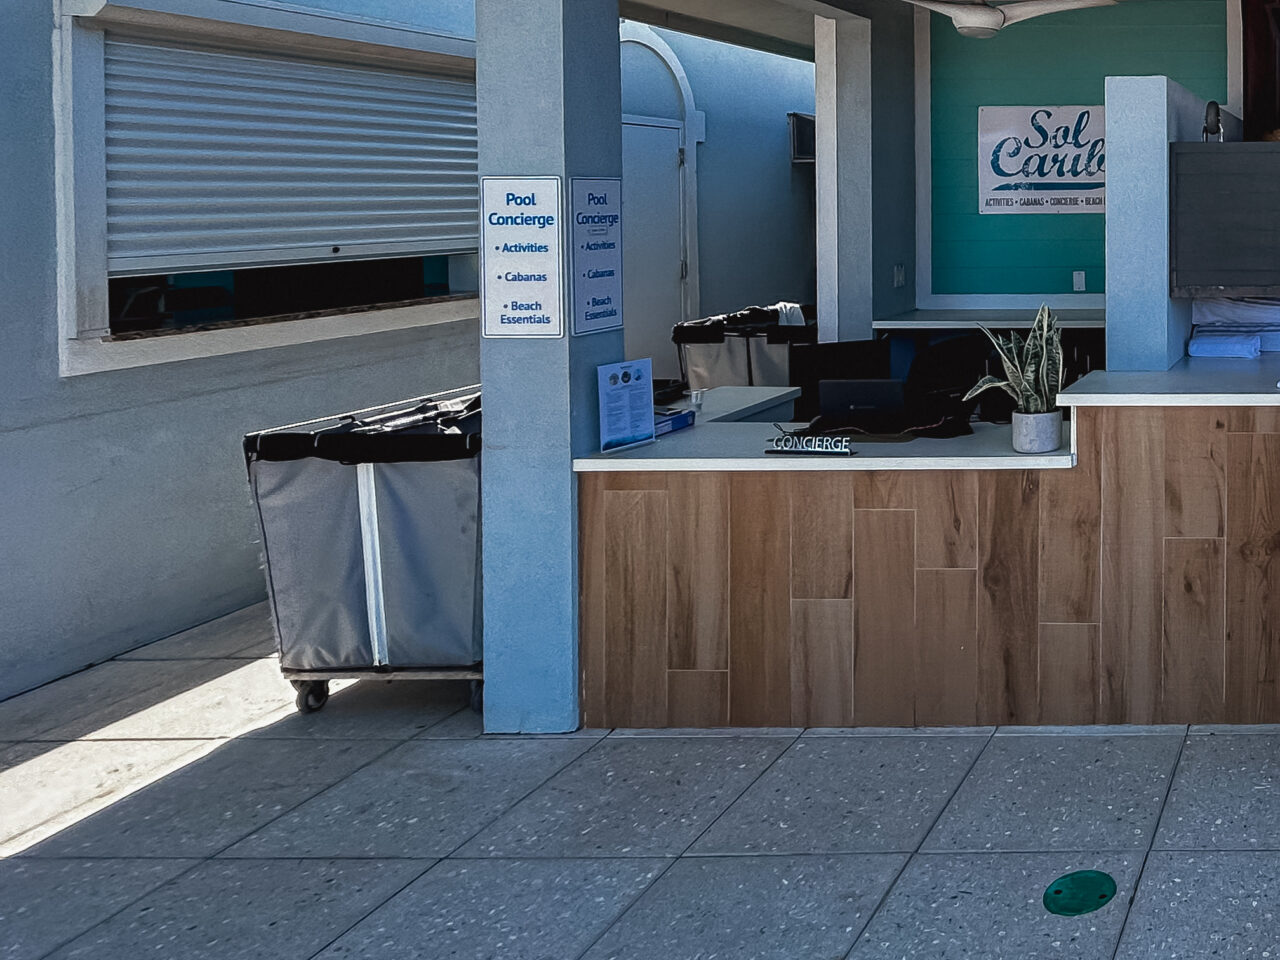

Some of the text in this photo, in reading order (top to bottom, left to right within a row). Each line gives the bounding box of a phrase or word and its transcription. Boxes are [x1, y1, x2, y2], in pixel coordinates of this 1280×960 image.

[1024, 109, 1090, 149] Sol
[990, 137, 1105, 178] Carib
[506, 192, 536, 206] Pool
[588, 192, 608, 206] Pool
[488, 213, 555, 229] Concierge
[576, 212, 619, 227] Concierge
[502, 243, 549, 253] Activities
[585, 240, 616, 251] Activities
[504, 272, 547, 282] Cabanas
[587, 269, 615, 279] Cabanas
[511, 301, 542, 311] Beach
[592, 296, 611, 307] Beach
[500, 314, 551, 325] Essentials
[585, 307, 617, 321] Essentials
[773, 436, 850, 451] CONCIERGE
